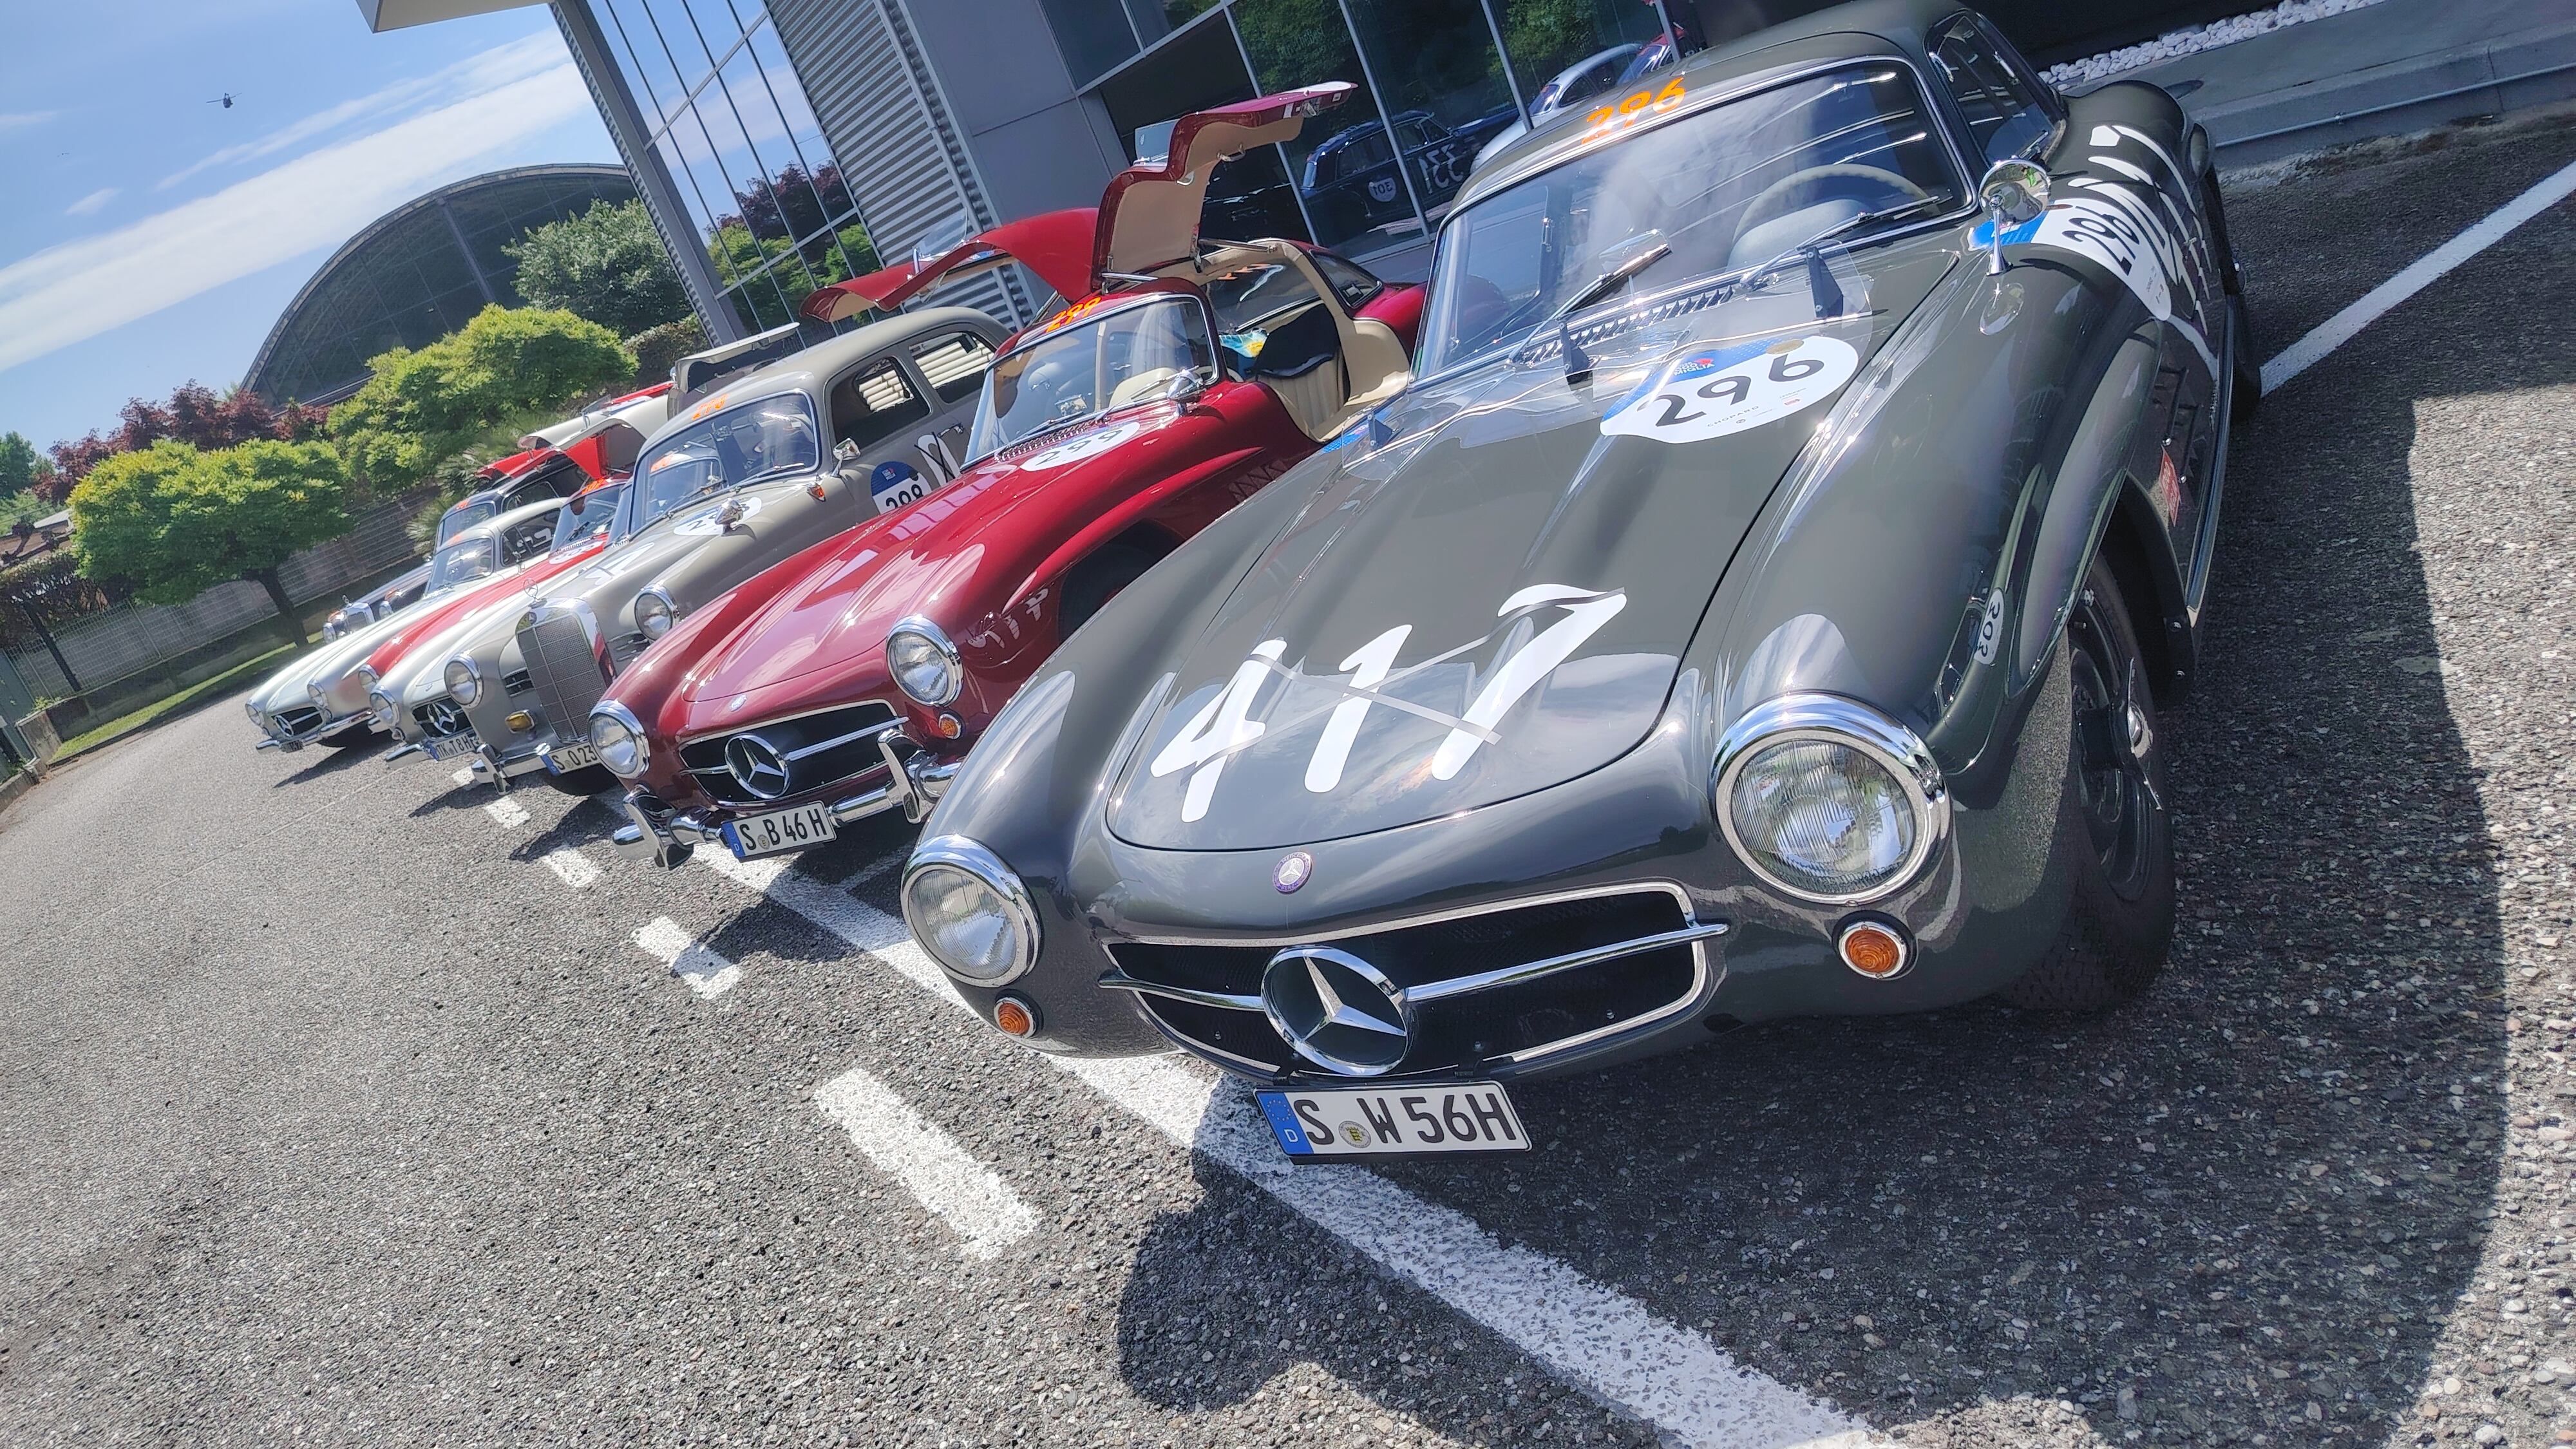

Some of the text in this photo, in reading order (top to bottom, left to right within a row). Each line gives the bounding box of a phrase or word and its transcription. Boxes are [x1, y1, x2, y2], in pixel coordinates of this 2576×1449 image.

[1582, 76, 1686, 142] 296
[2062, 205, 2139, 276] 296
[1636, 354, 1824, 428] 296
[1035, 430, 1122, 466] 299
[1150, 583, 1627, 822] 417
[552, 755, 565, 770] S
[739, 824, 757, 851] S
[762, 819, 781, 846] B
[1283, 1128, 1299, 1143] D
[1293, 1099, 1335, 1145] S
[1356, 1097, 1403, 1144] W
[1399, 1092, 1517, 1142] 56H
